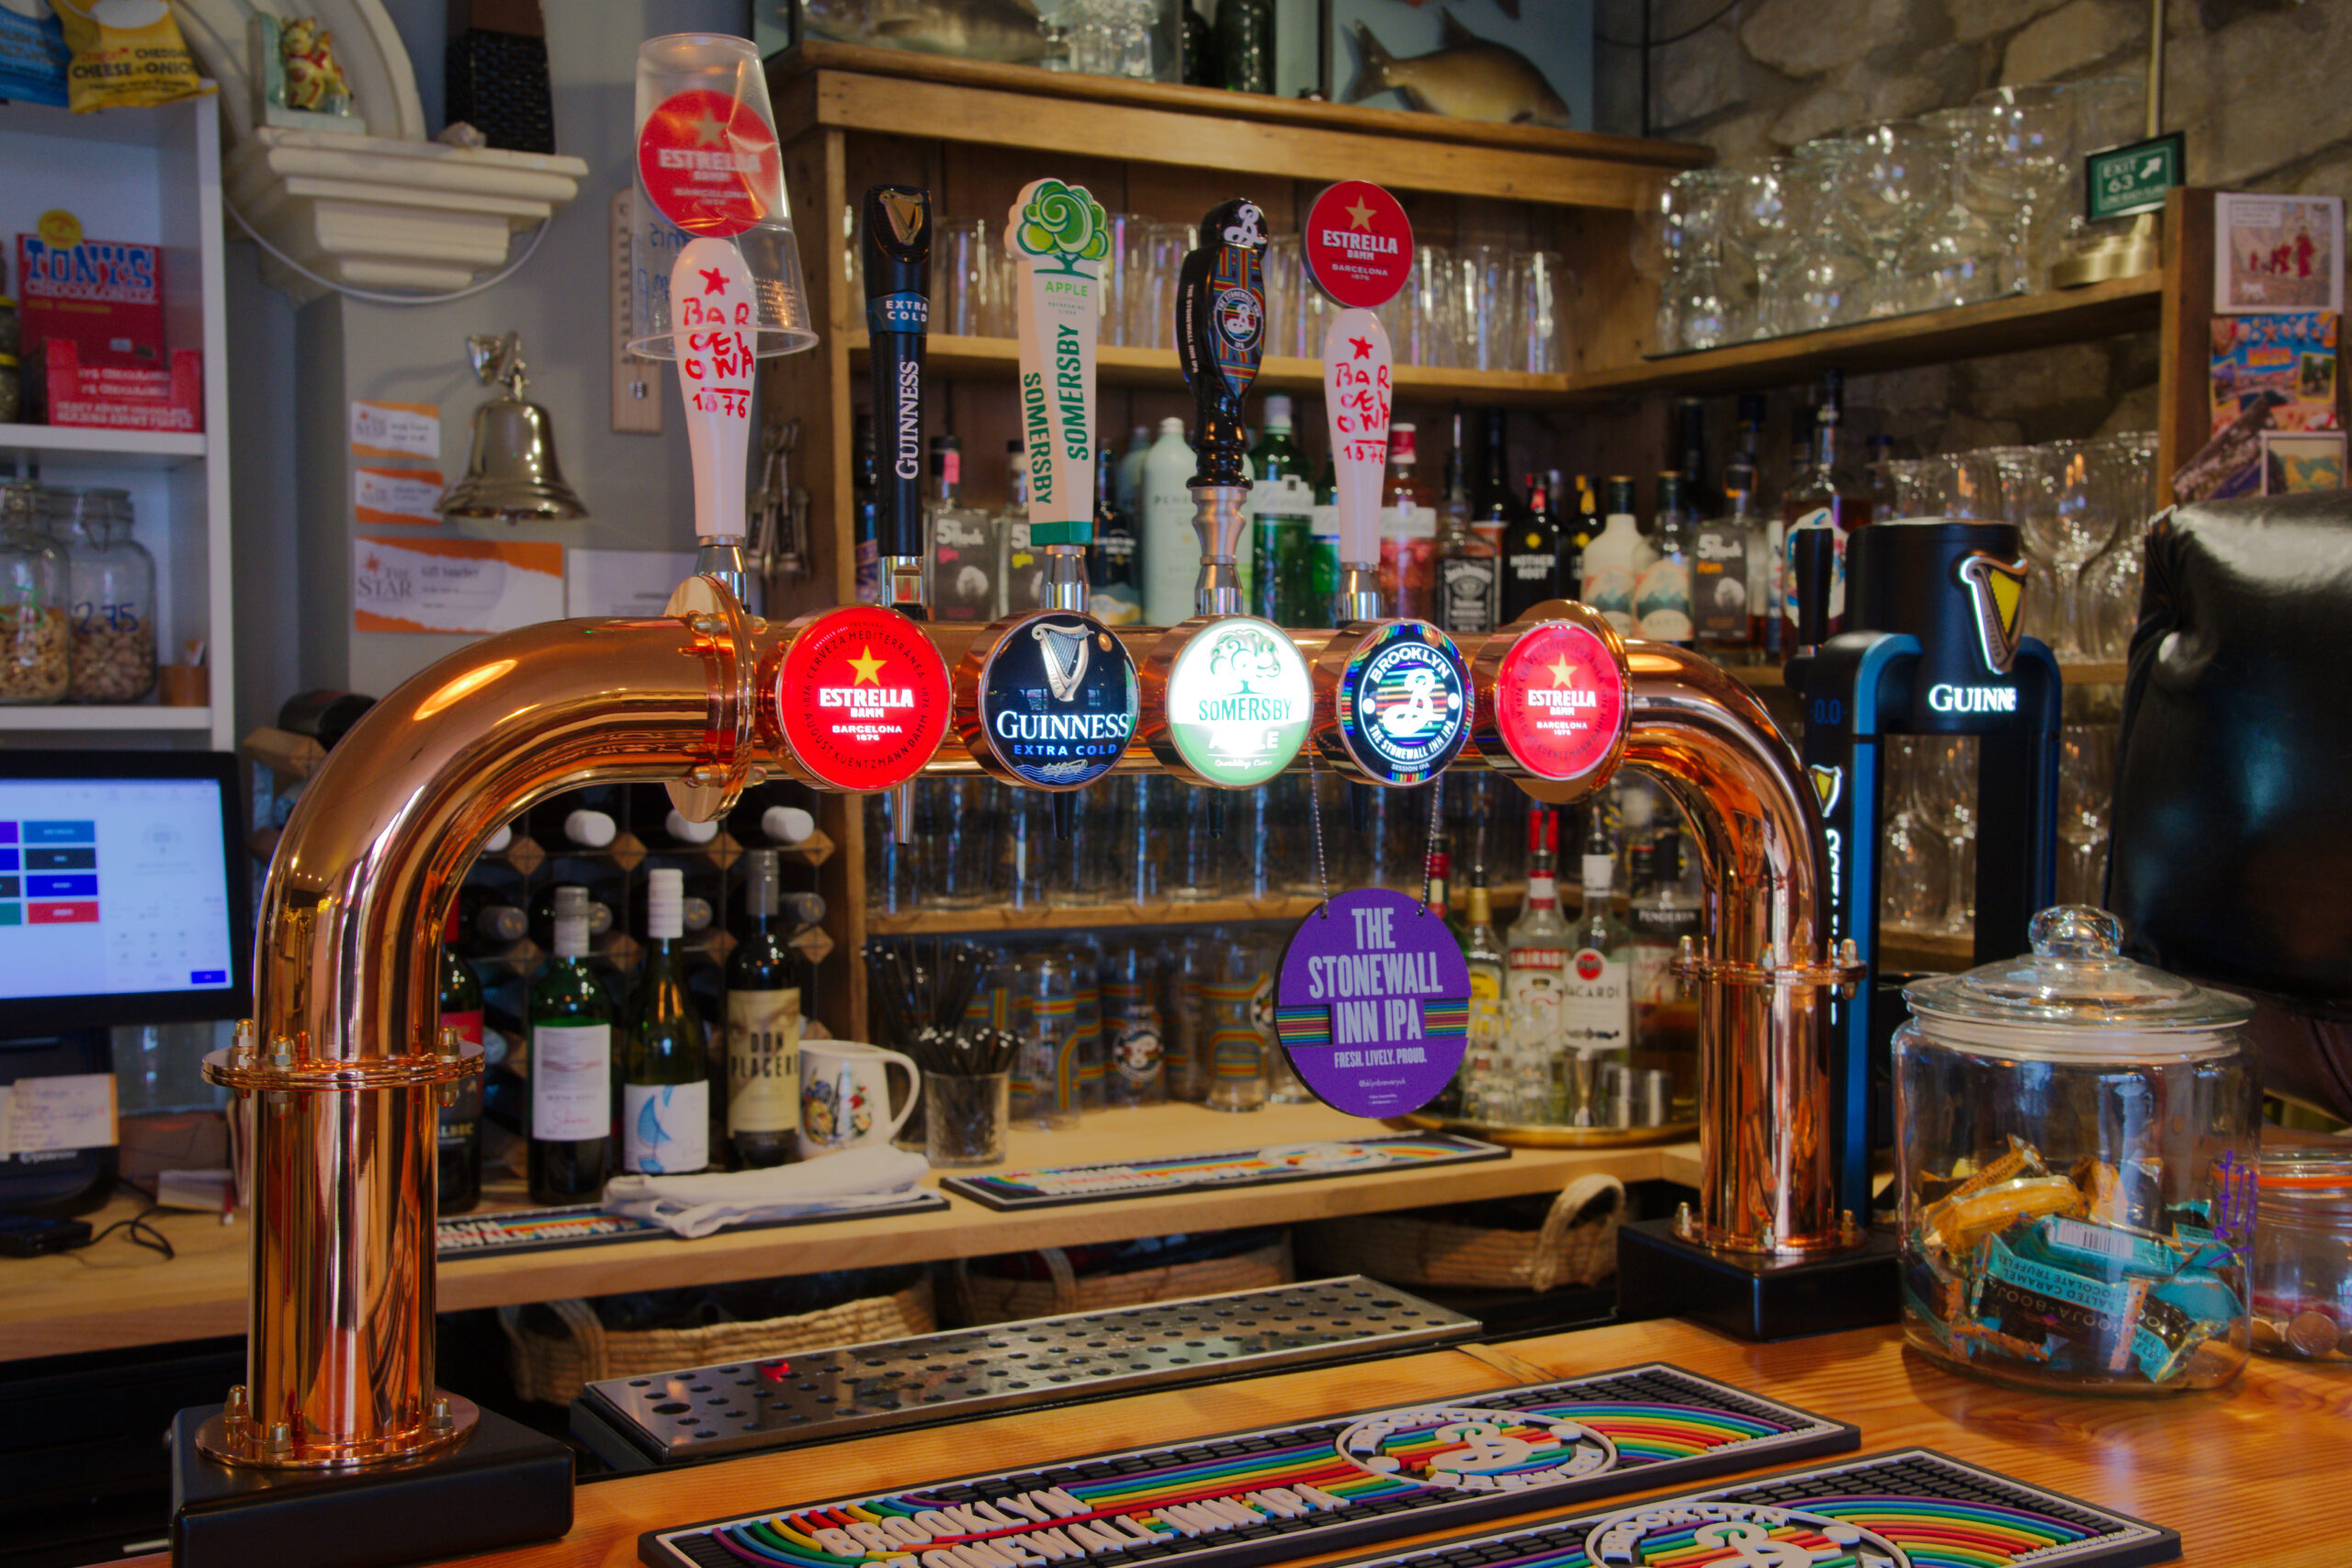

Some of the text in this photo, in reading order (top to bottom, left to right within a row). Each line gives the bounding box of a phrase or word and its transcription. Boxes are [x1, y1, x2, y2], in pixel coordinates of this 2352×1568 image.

[72, 62, 132, 79] CHEESE
[658, 148, 762, 173] ESTRELLA
[2103, 157, 2137, 179] EXIT
[2108, 174, 2134, 193] 63
[1323, 230, 1398, 254] ESTRELLA
[1347, 249, 1374, 262] DAMM
[1331, 263, 1388, 276] BARCELONA
[1044, 281, 1089, 297] APPLE
[1186, 284, 1194, 298] THE
[683, 296, 750, 326] BAR
[885, 299, 928, 312] EXTRA
[887, 310, 927, 322] COLD
[1335, 362, 1390, 389] BAR
[1056, 323, 1089, 461] SOMERSBY
[692, 392, 747, 419] 1876
[895, 360, 919, 479] GUINNESS
[1023, 371, 1053, 505] SOMERSBY
[1342, 444, 1385, 465] 1876
[356, 577, 413, 599] STAR
[808, 629, 926, 680] CERVEZA MEDITERRANEA
[1368, 647, 1452, 683] BROOKLYN
[819, 688, 914, 707] ESTRELLA
[1198, 697, 1293, 722] SOMERSBY
[1528, 689, 1597, 707] ESTRELLA
[850, 707, 885, 718] DAMM
[1814, 698, 1841, 726] 0.0
[831, 725, 903, 734] BARCELONA
[996, 710, 1131, 740] GUINNESS
[1536, 721, 1589, 729] BARCELONA
[803, 712, 929, 770] AUGUST KUENTZMANN DAMM
[1012, 743, 1118, 756] EXTRA COLD
[1368, 719, 1456, 761] THE STONEWALL INN IPA
[1390, 762, 1419, 772] SESSION
[1351, 907, 1396, 950] THE
[1307, 952, 1444, 999] STONEWALL
[1336, 998, 1422, 1044] INN IPA
[750, 1031, 786, 1054] DON
[1334, 1047, 1428, 1068] FRESH. LIVELY. PROUD.
[1997, 1254, 2051, 1281] TRUFFLES
[2002, 1268, 2113, 1312] SALTED CARAMEL
[1349, 1410, 1527, 1456] BROOKLYN
[810, 1485, 1093, 1559] BROOKLYN
[1152, 1496, 1269, 1539] INN
[1245, 1482, 1351, 1519] IPA
[1600, 1504, 1791, 1564] BROOKLYN
